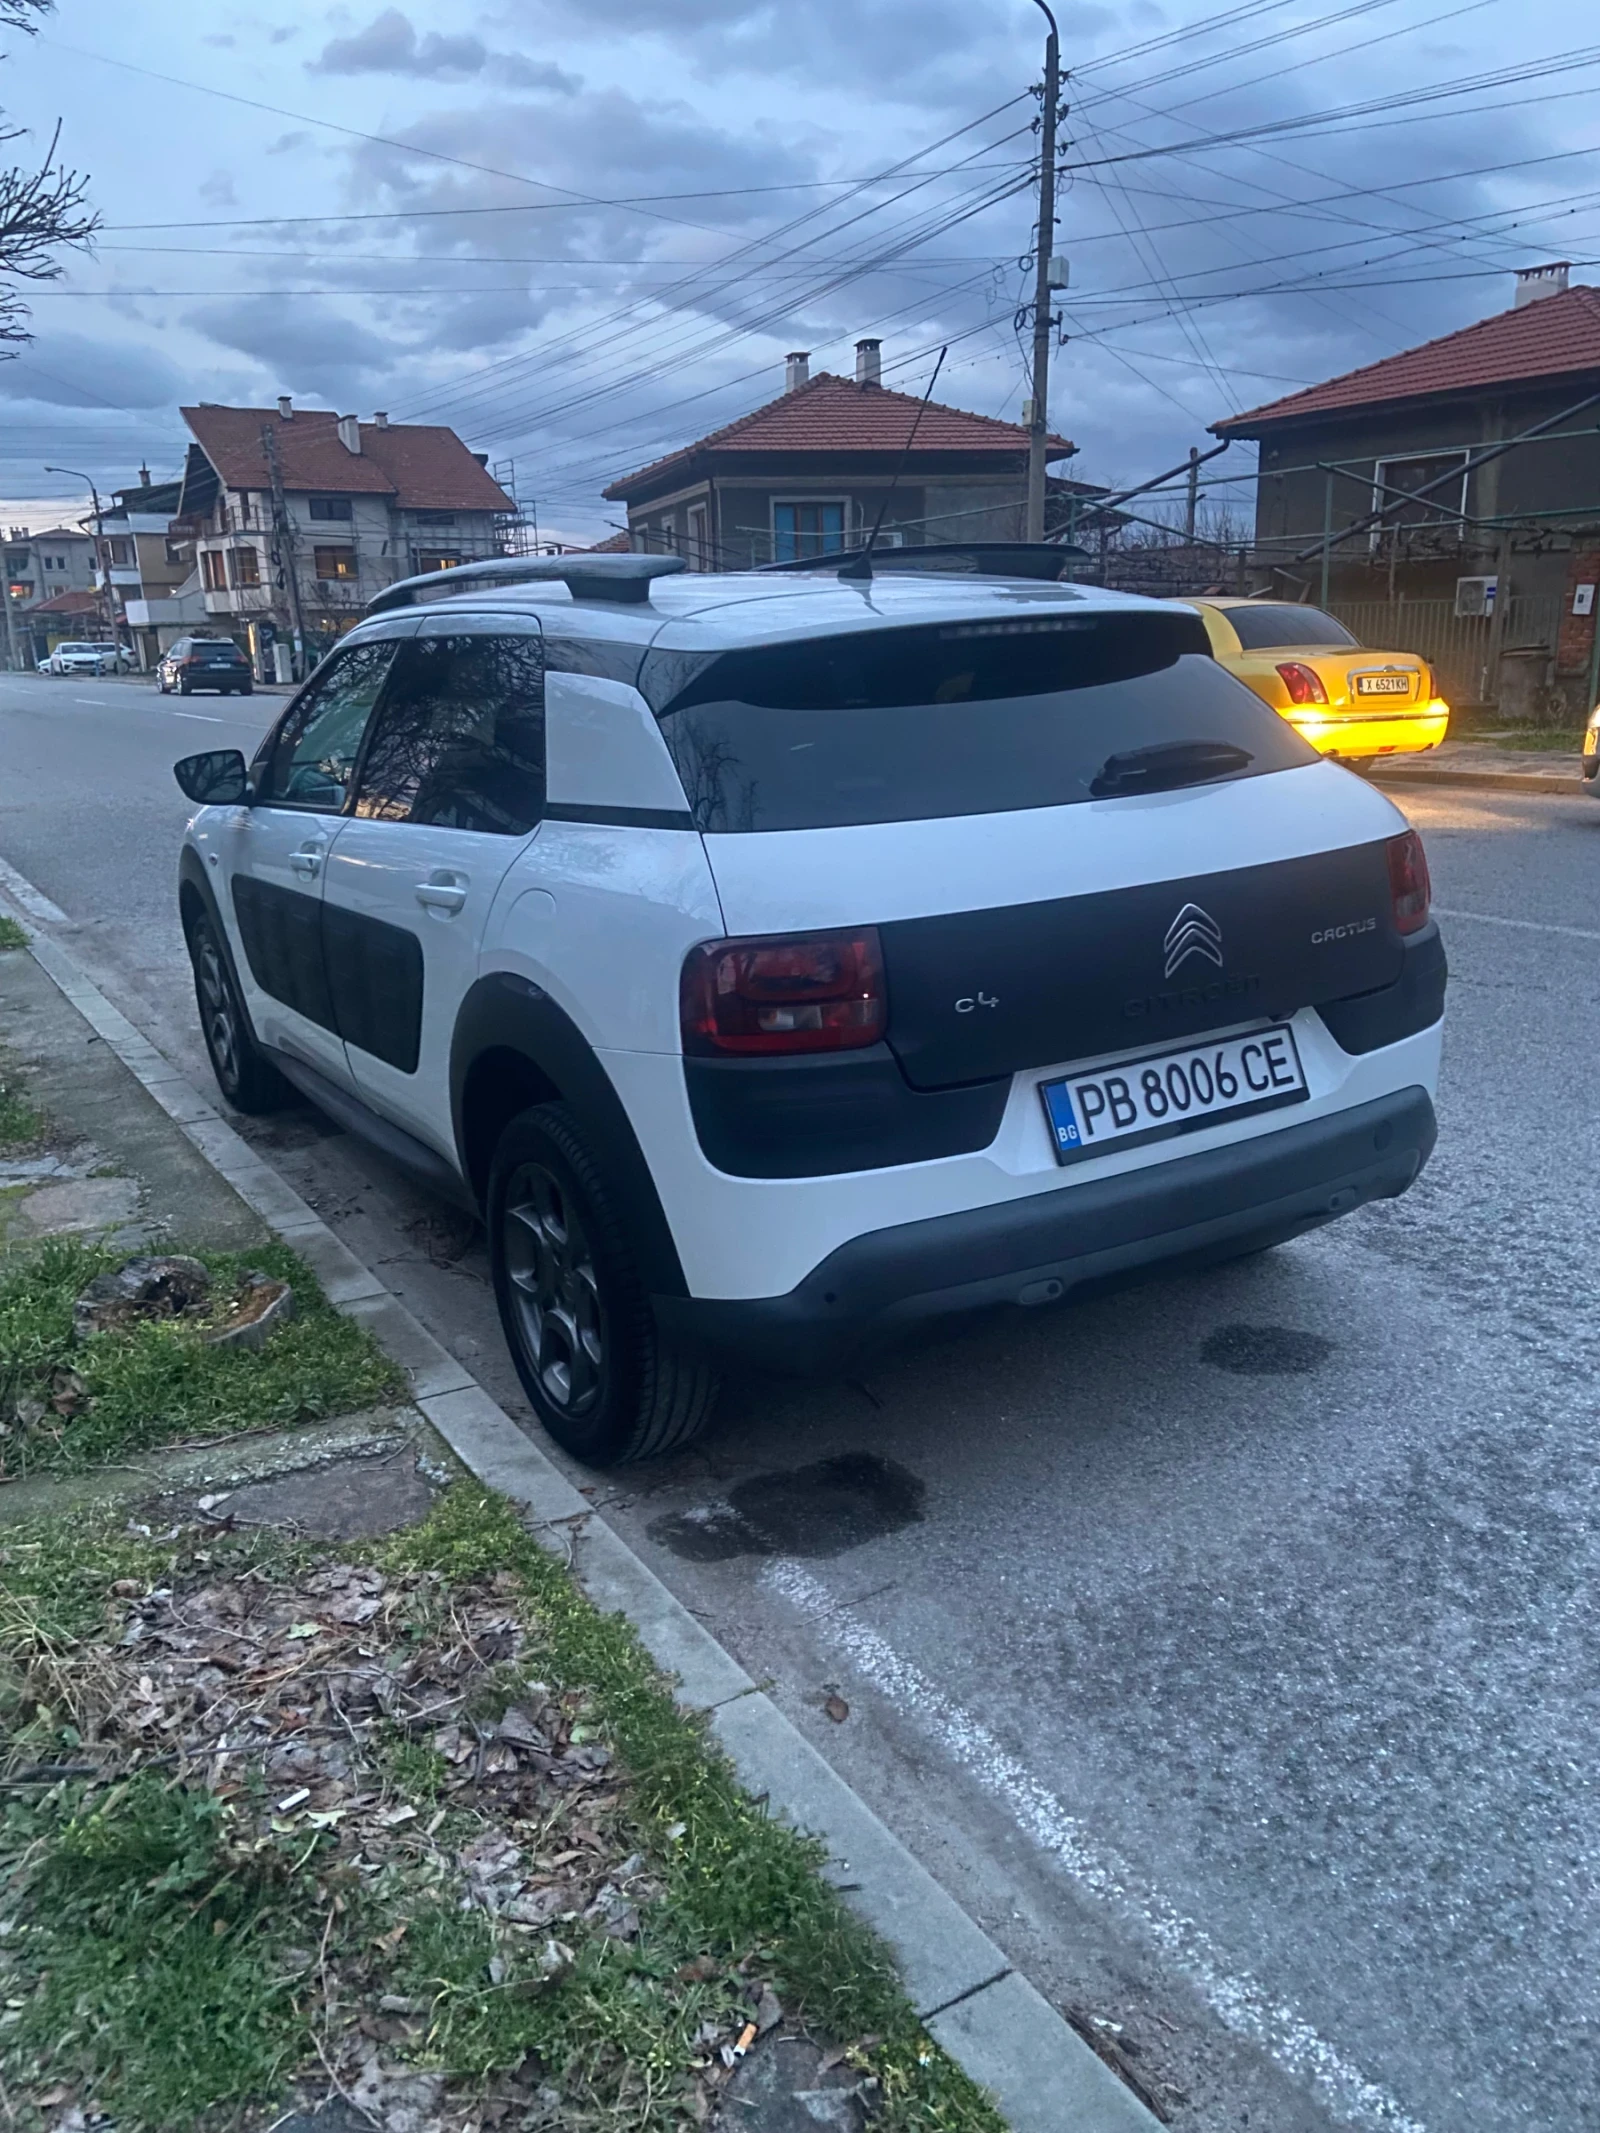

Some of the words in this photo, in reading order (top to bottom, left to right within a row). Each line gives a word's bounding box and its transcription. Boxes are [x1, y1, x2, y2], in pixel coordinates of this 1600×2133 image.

[1311, 917, 1377, 944] CACTUS
[955, 991, 1000, 1013] C4
[1057, 1123, 1078, 1143] BG
